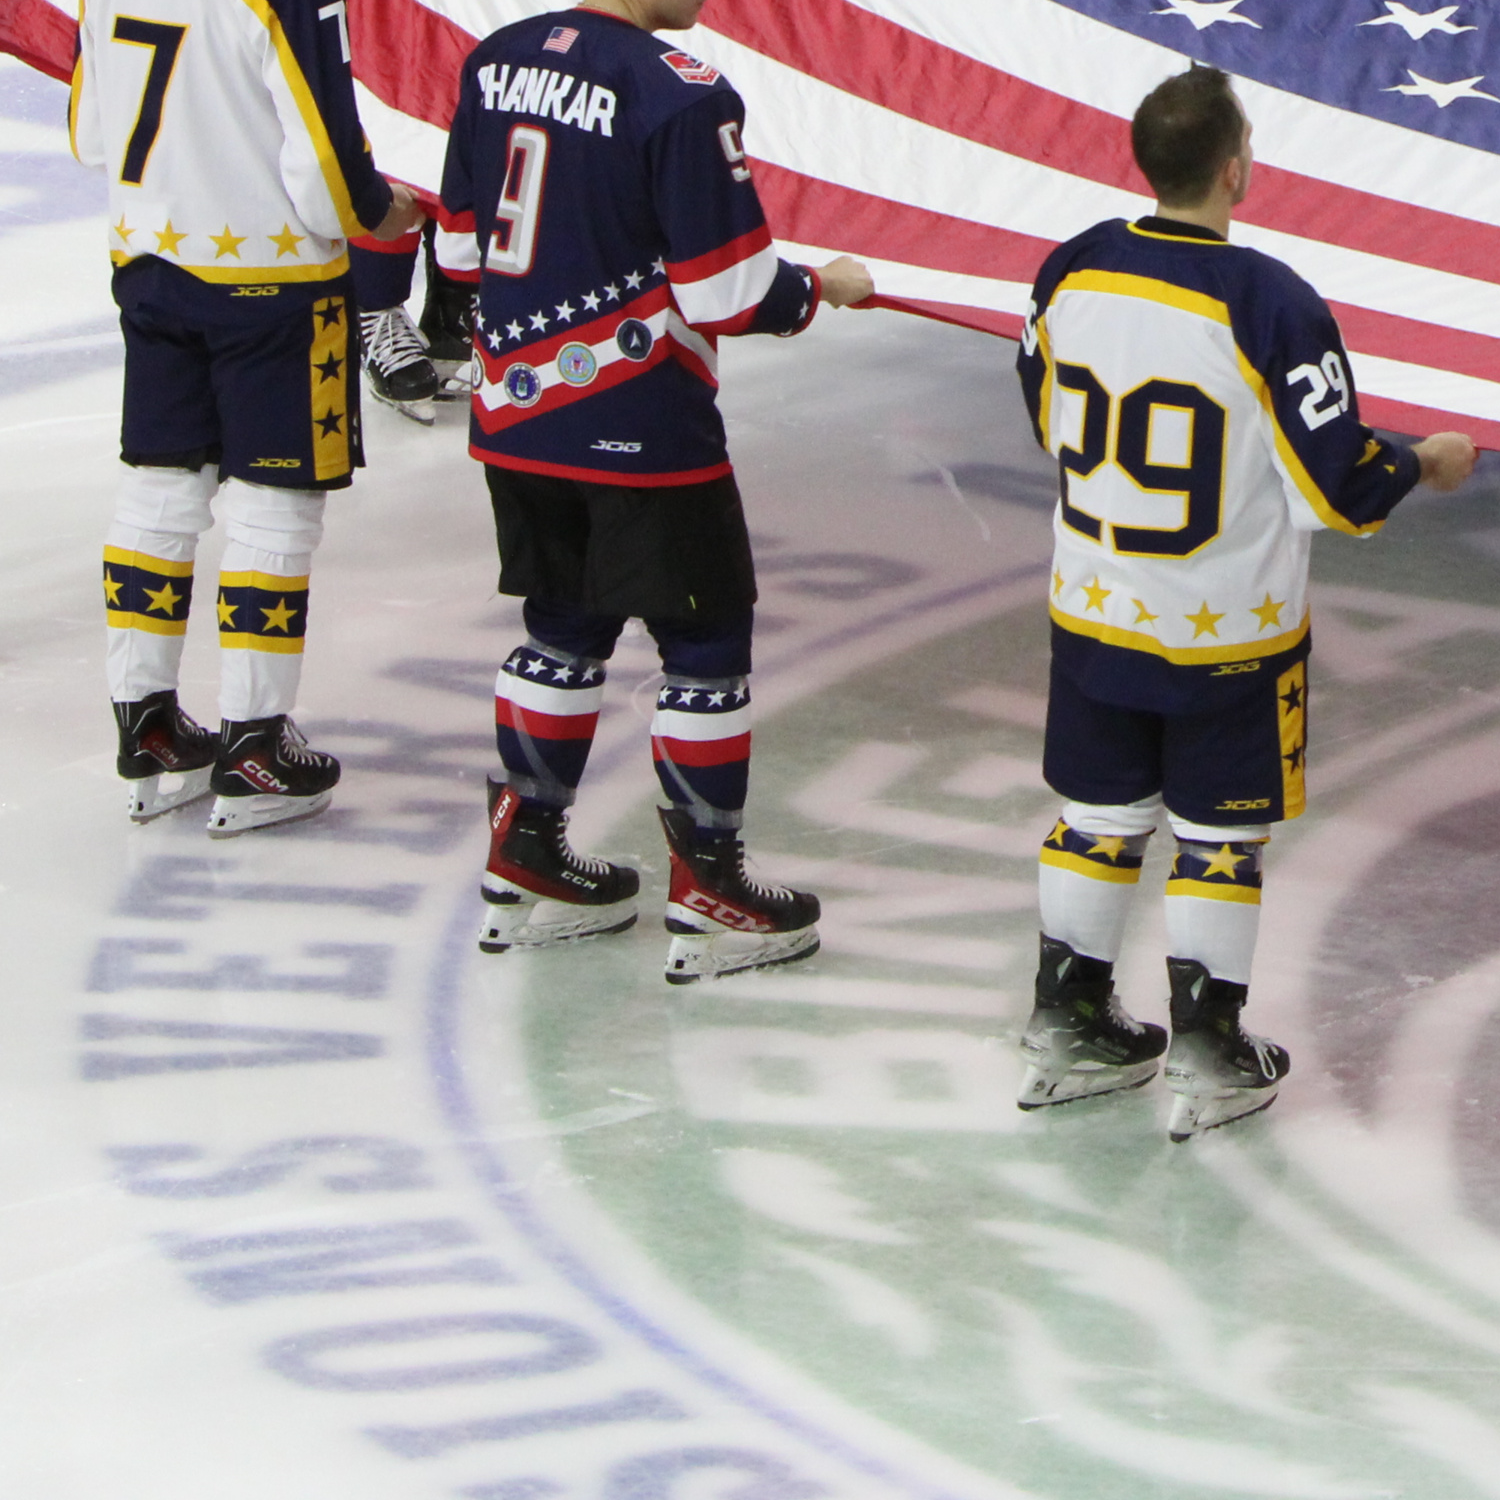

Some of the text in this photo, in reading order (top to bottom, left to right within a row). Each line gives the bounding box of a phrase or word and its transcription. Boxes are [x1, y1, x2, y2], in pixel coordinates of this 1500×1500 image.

[318, 0, 351, 64] 7
[110, 14, 190, 187] 7
[719, 122, 750, 182] 9
[485, 122, 550, 278] 9
[1287, 351, 1348, 432] 29
[1055, 360, 1229, 558] 29
[153, 741, 178, 764] CCM
[242, 760, 289, 792] CCM
[492, 793, 512, 830] CCM
[560, 870, 598, 890] CCM
[683, 890, 775, 932] CCM
